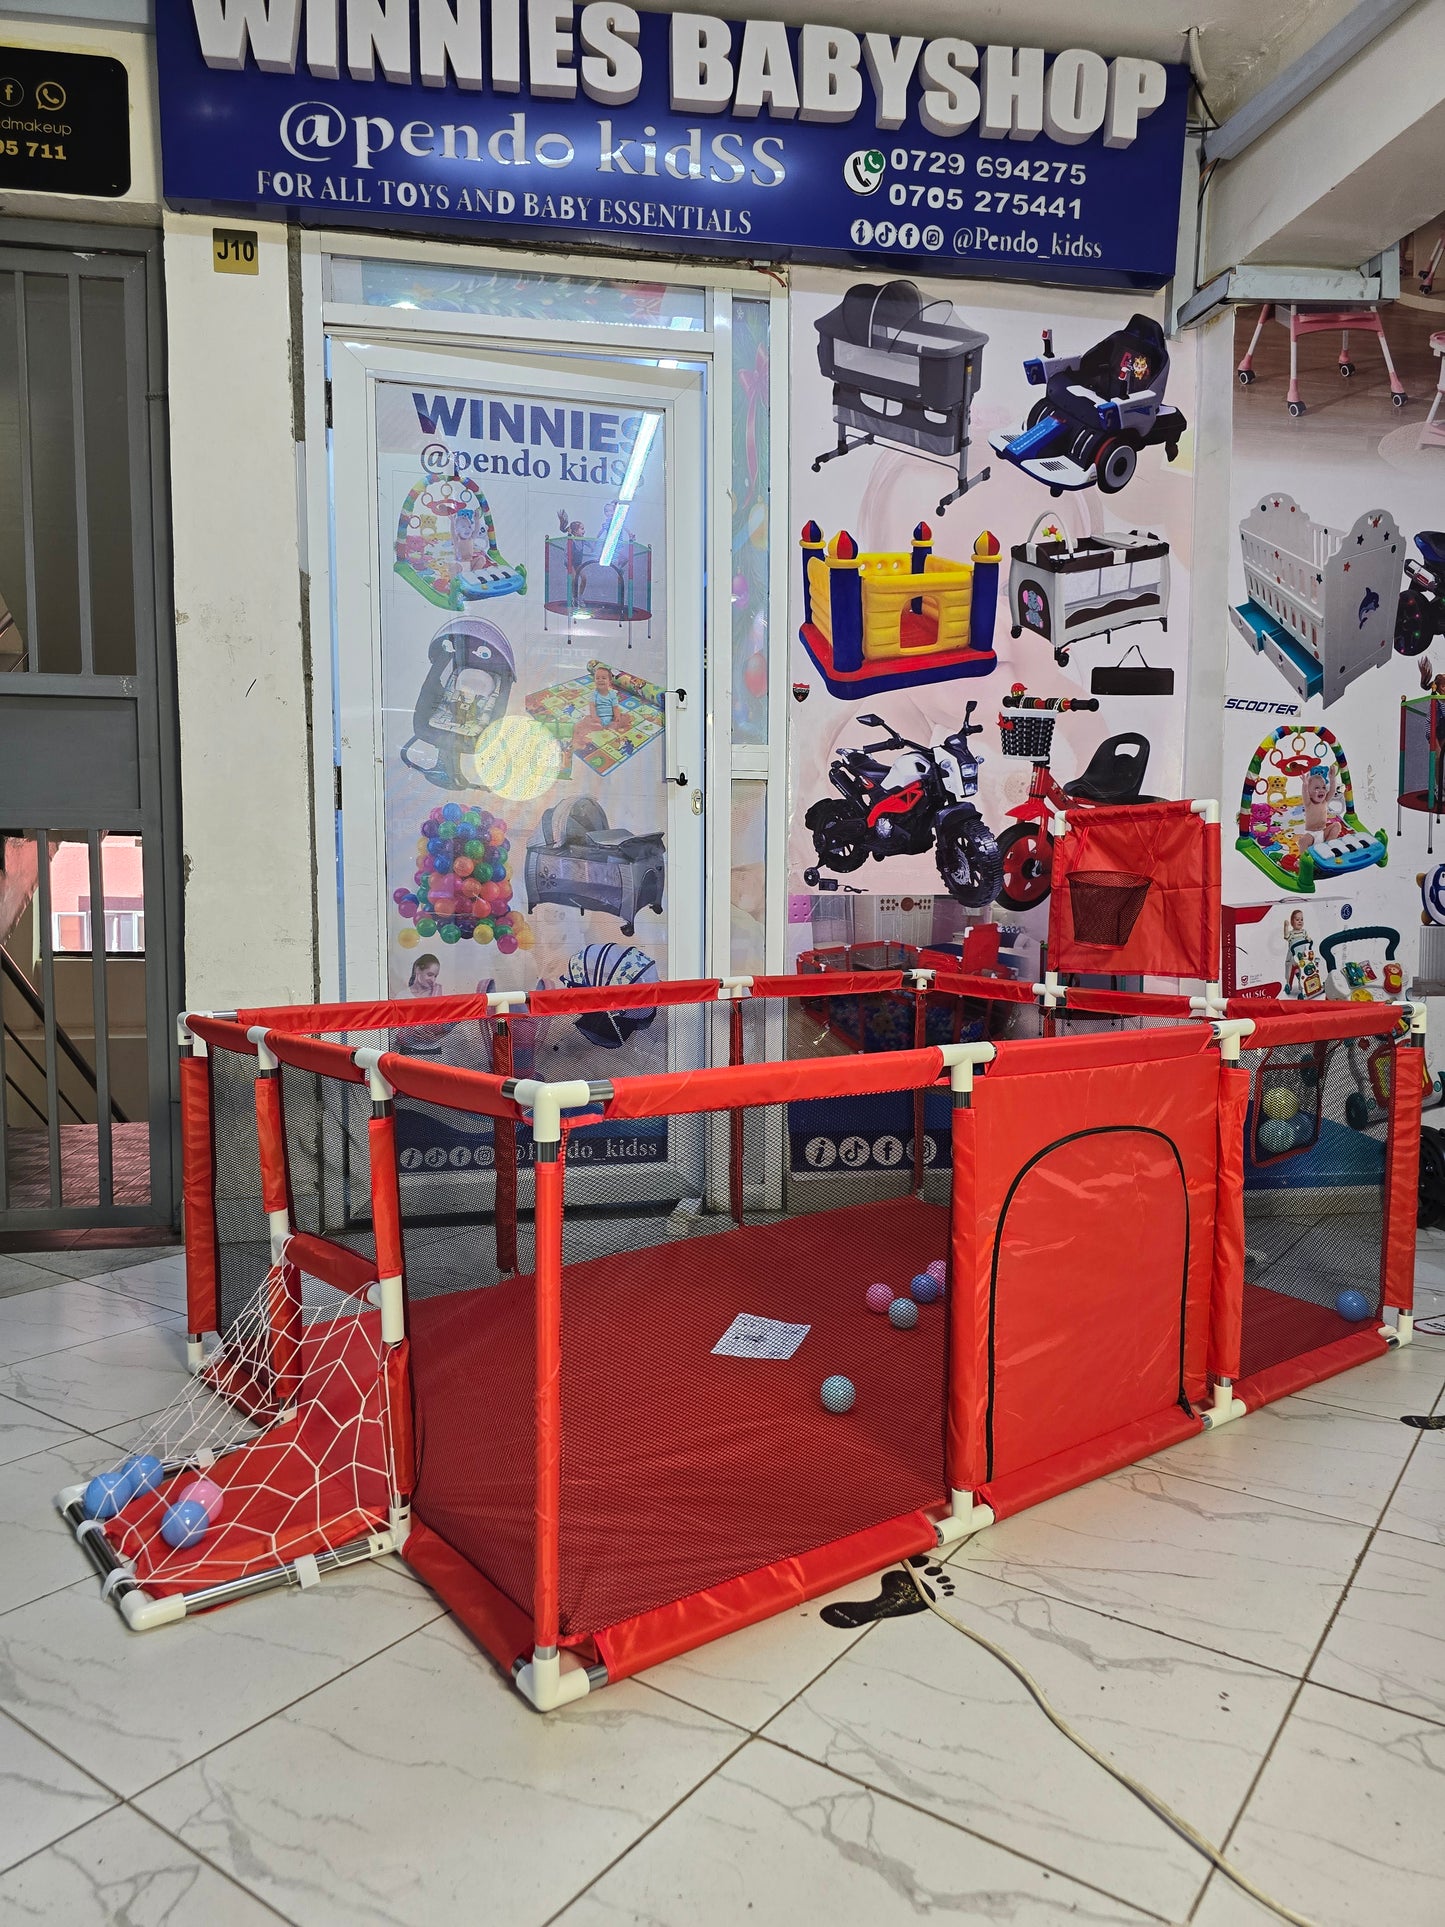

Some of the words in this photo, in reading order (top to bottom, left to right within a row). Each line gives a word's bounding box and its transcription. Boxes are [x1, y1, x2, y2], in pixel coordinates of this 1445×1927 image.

[193, 0, 642, 105] WINNIES
[669, 12, 1167, 149] BABYSHOP
[1, 116, 72, 137] dmakeup
[280, 101, 575, 170] @pendo
[596, 119, 786, 187] kidSS
[26, 141, 67, 160] 711
[890, 148, 966, 176] 0729
[975, 155, 1087, 185] 694275
[257, 170, 315, 199] FOR
[320, 176, 372, 204] ALL
[378, 180, 450, 211] TOYS
[456, 188, 516, 215] AND
[523, 192, 592, 222] BABY
[599, 198, 752, 235] ESSENTIALS
[889, 183, 963, 210] 0705
[974, 191, 1082, 220] 275441
[217, 239, 254, 262] J10
[952, 226, 1102, 259] @Pendo_kidss
[420, 443, 550, 479] @pendo
[559, 453, 645, 488] kidS
[1224, 698, 1299, 716] SCOOTER
